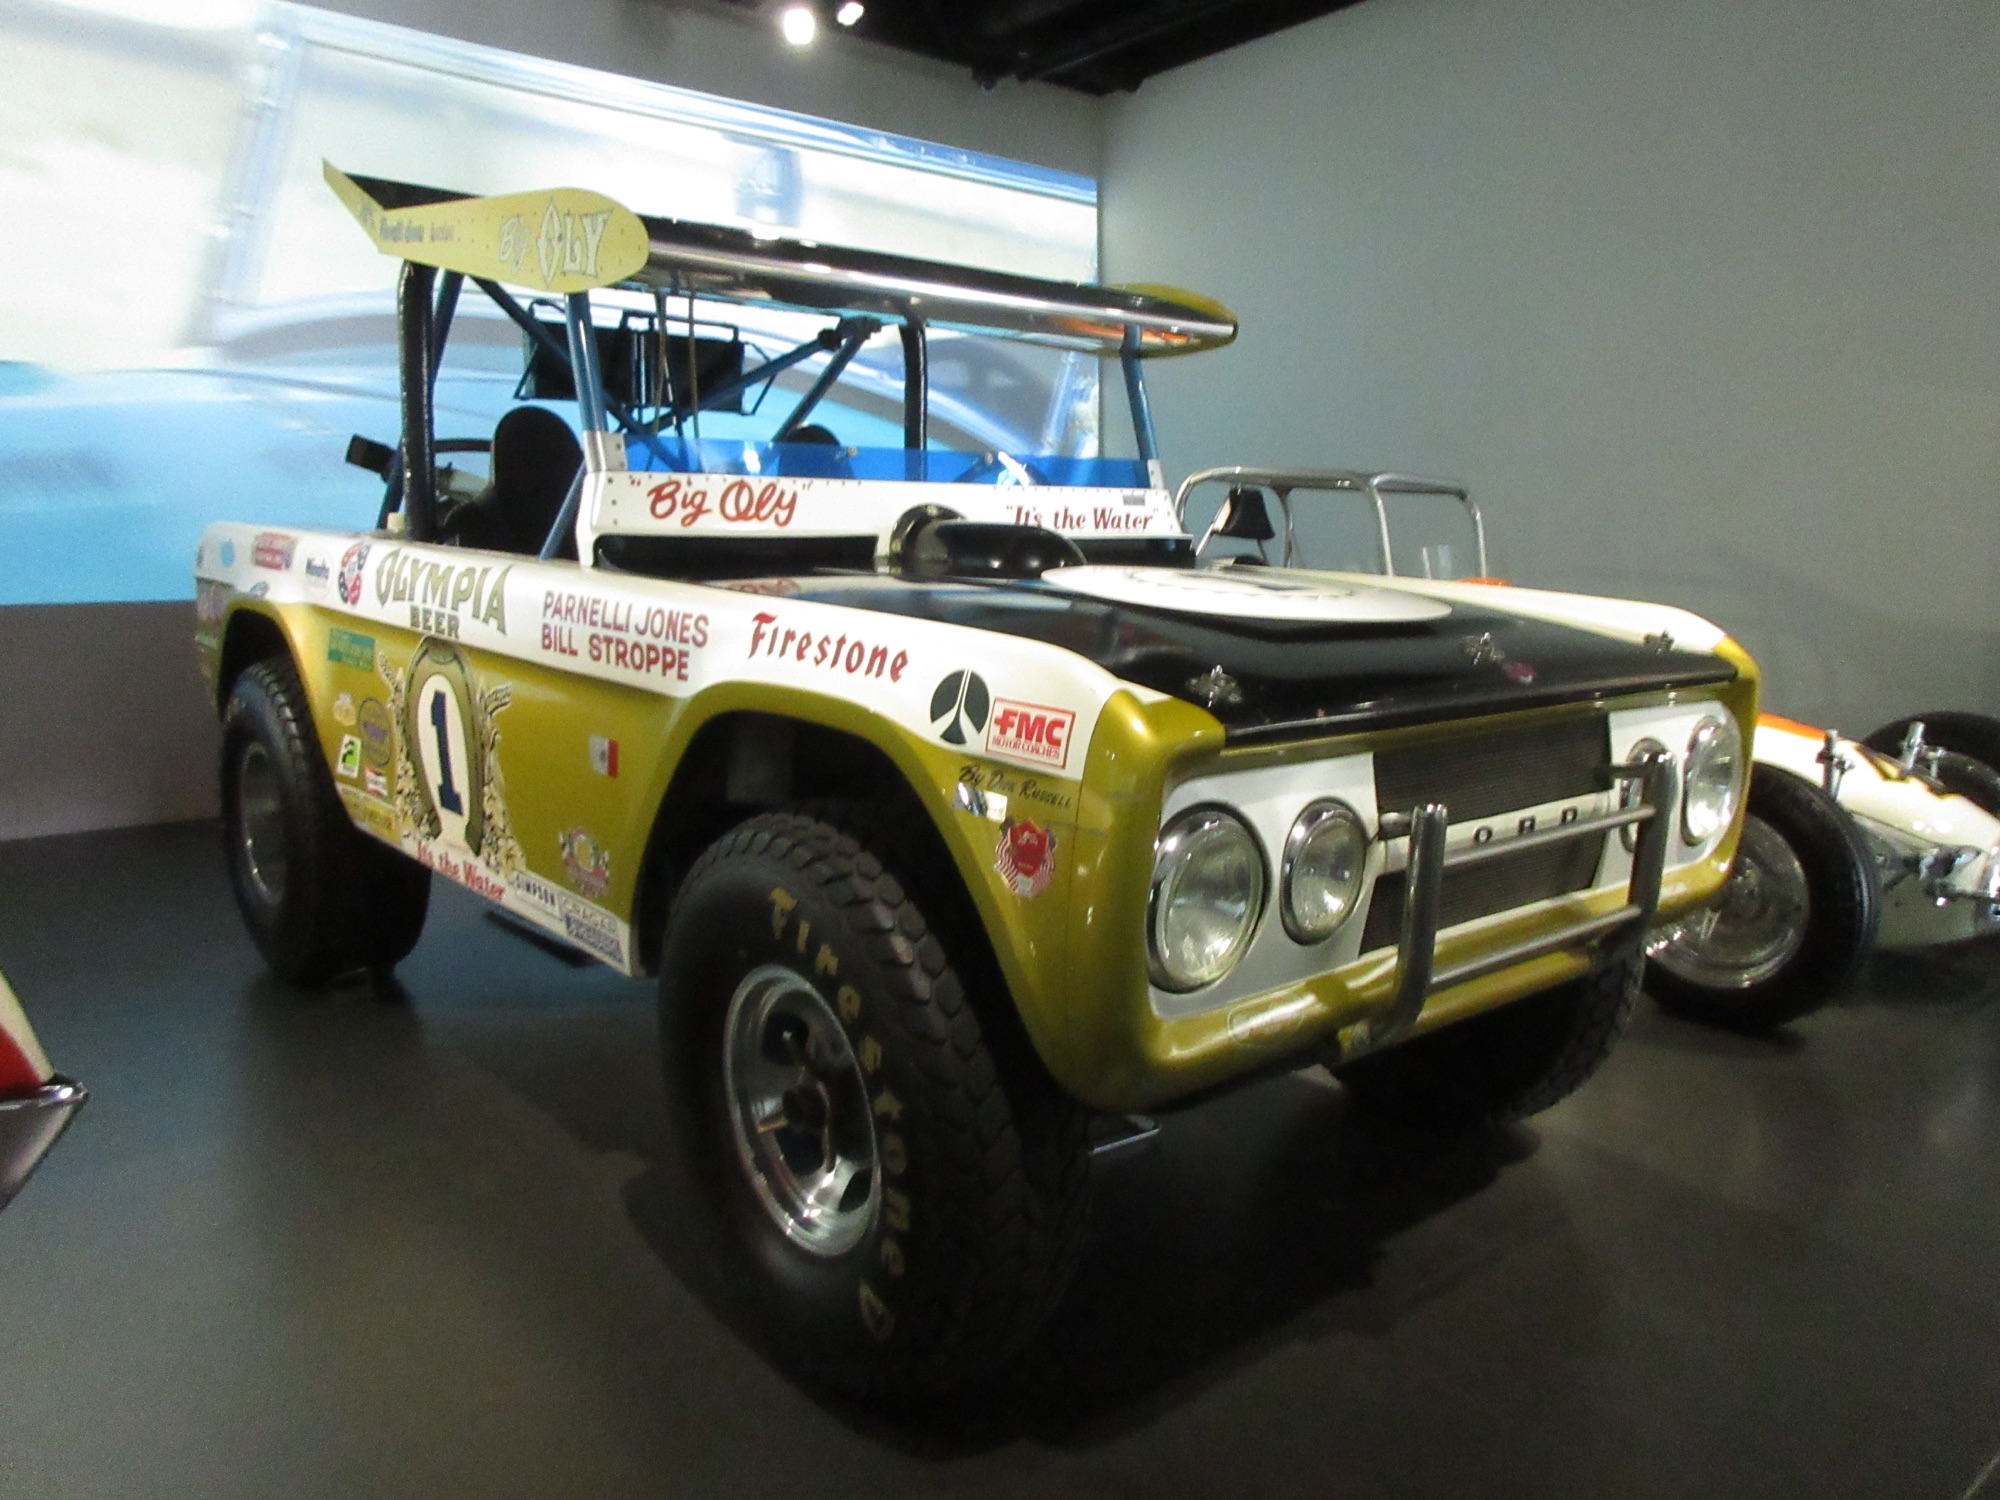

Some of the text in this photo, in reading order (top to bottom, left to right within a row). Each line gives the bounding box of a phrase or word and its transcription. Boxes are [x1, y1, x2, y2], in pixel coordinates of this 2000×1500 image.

[1053, 507, 1086, 530] the
[375, 547, 516, 636] OLYMPIA
[409, 605, 460, 640] BEER
[542, 590, 710, 648] PARNELLI JONES
[541, 622, 690, 682] BILL STROPPE
[747, 611, 909, 684] Firestone
[991, 734, 1022, 751] MOTOR
[994, 708, 1067, 748] FMC
[430, 689, 464, 817] 1
[1473, 805, 1578, 845] ORD
